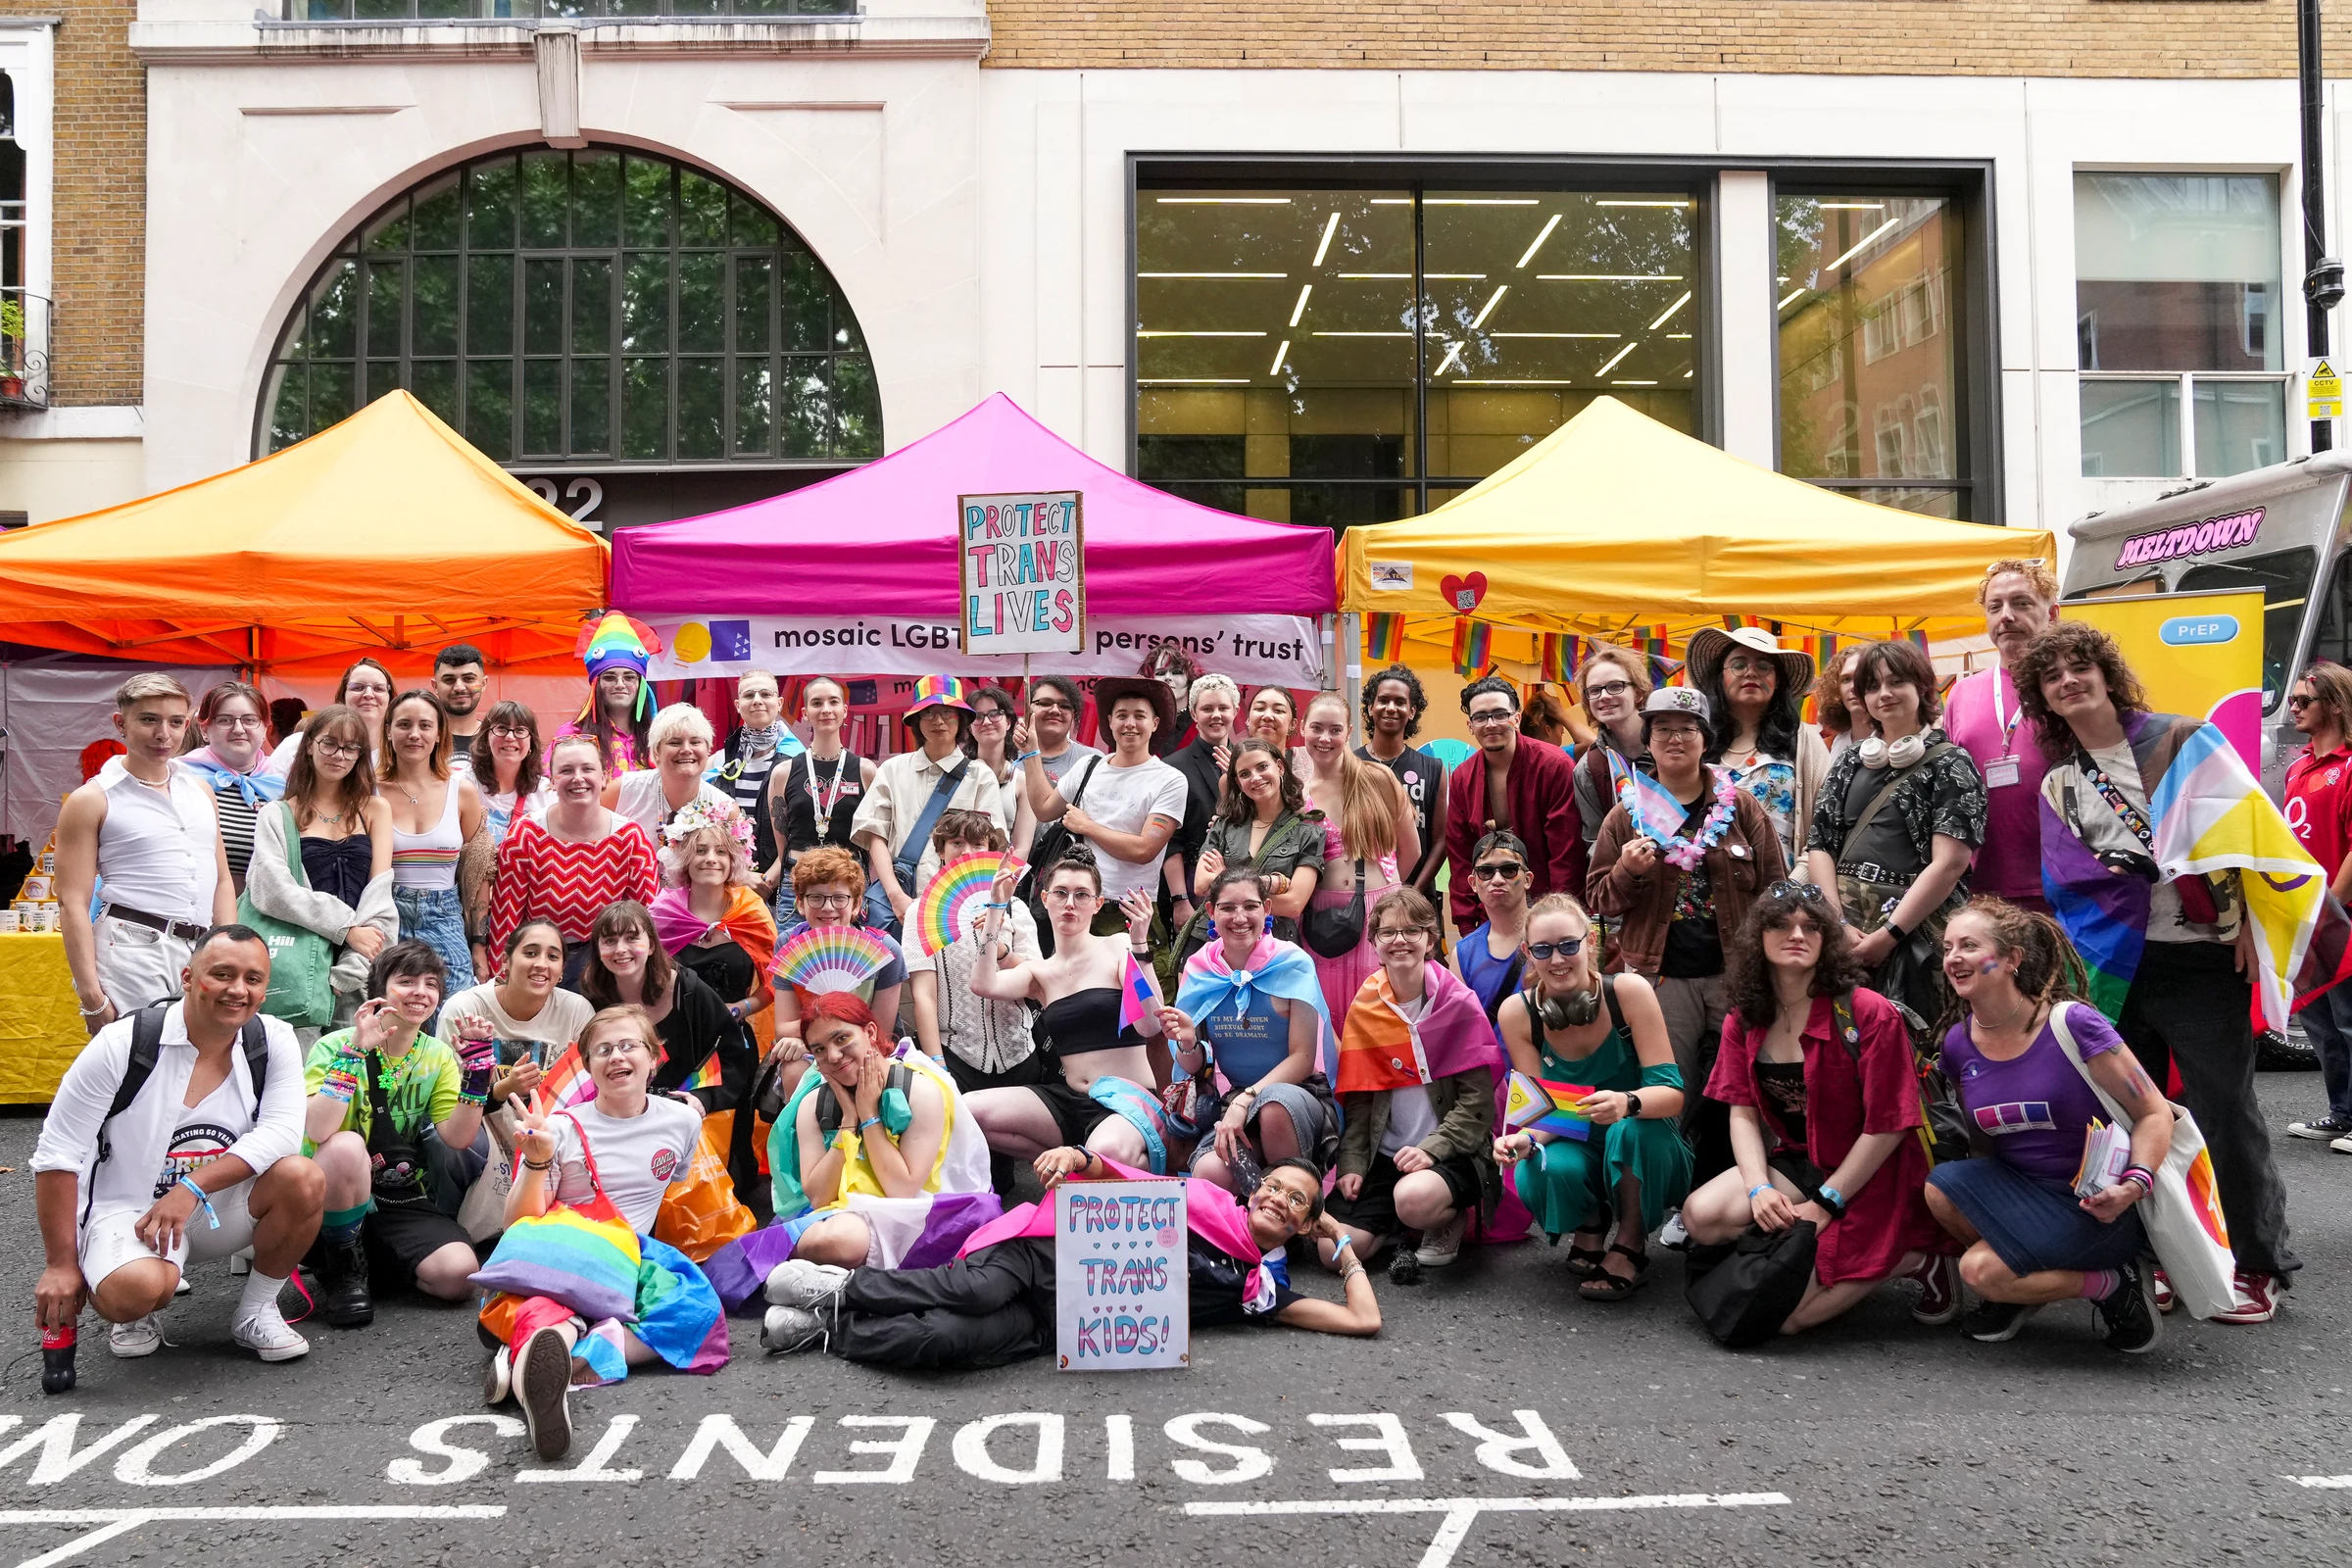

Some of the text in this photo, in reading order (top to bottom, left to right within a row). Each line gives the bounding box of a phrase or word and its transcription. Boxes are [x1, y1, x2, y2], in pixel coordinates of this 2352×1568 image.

[966, 501, 1075, 540] PROTECT
[2116, 510, 2264, 568] MELTDOWN
[968, 540, 1076, 588] TRANS
[969, 588, 1074, 637] LIVES
[2178, 623, 2220, 637] PrEP
[774, 621, 881, 648] mosaic
[1232, 633, 1304, 662] trust
[268, 935, 295, 947] Hill
[206, 1128, 218, 1137] 50
[218, 1132, 234, 1146] YEAR
[651, 1150, 675, 1171] SANTA
[655, 1160, 675, 1180] CRUZ
[1069, 1194, 1180, 1234] PROTECT
[1079, 1256, 1168, 1297] TRANS
[1078, 1314, 1170, 1358] KIDS!
[385, 1409, 1584, 1485] RESIDENTS
